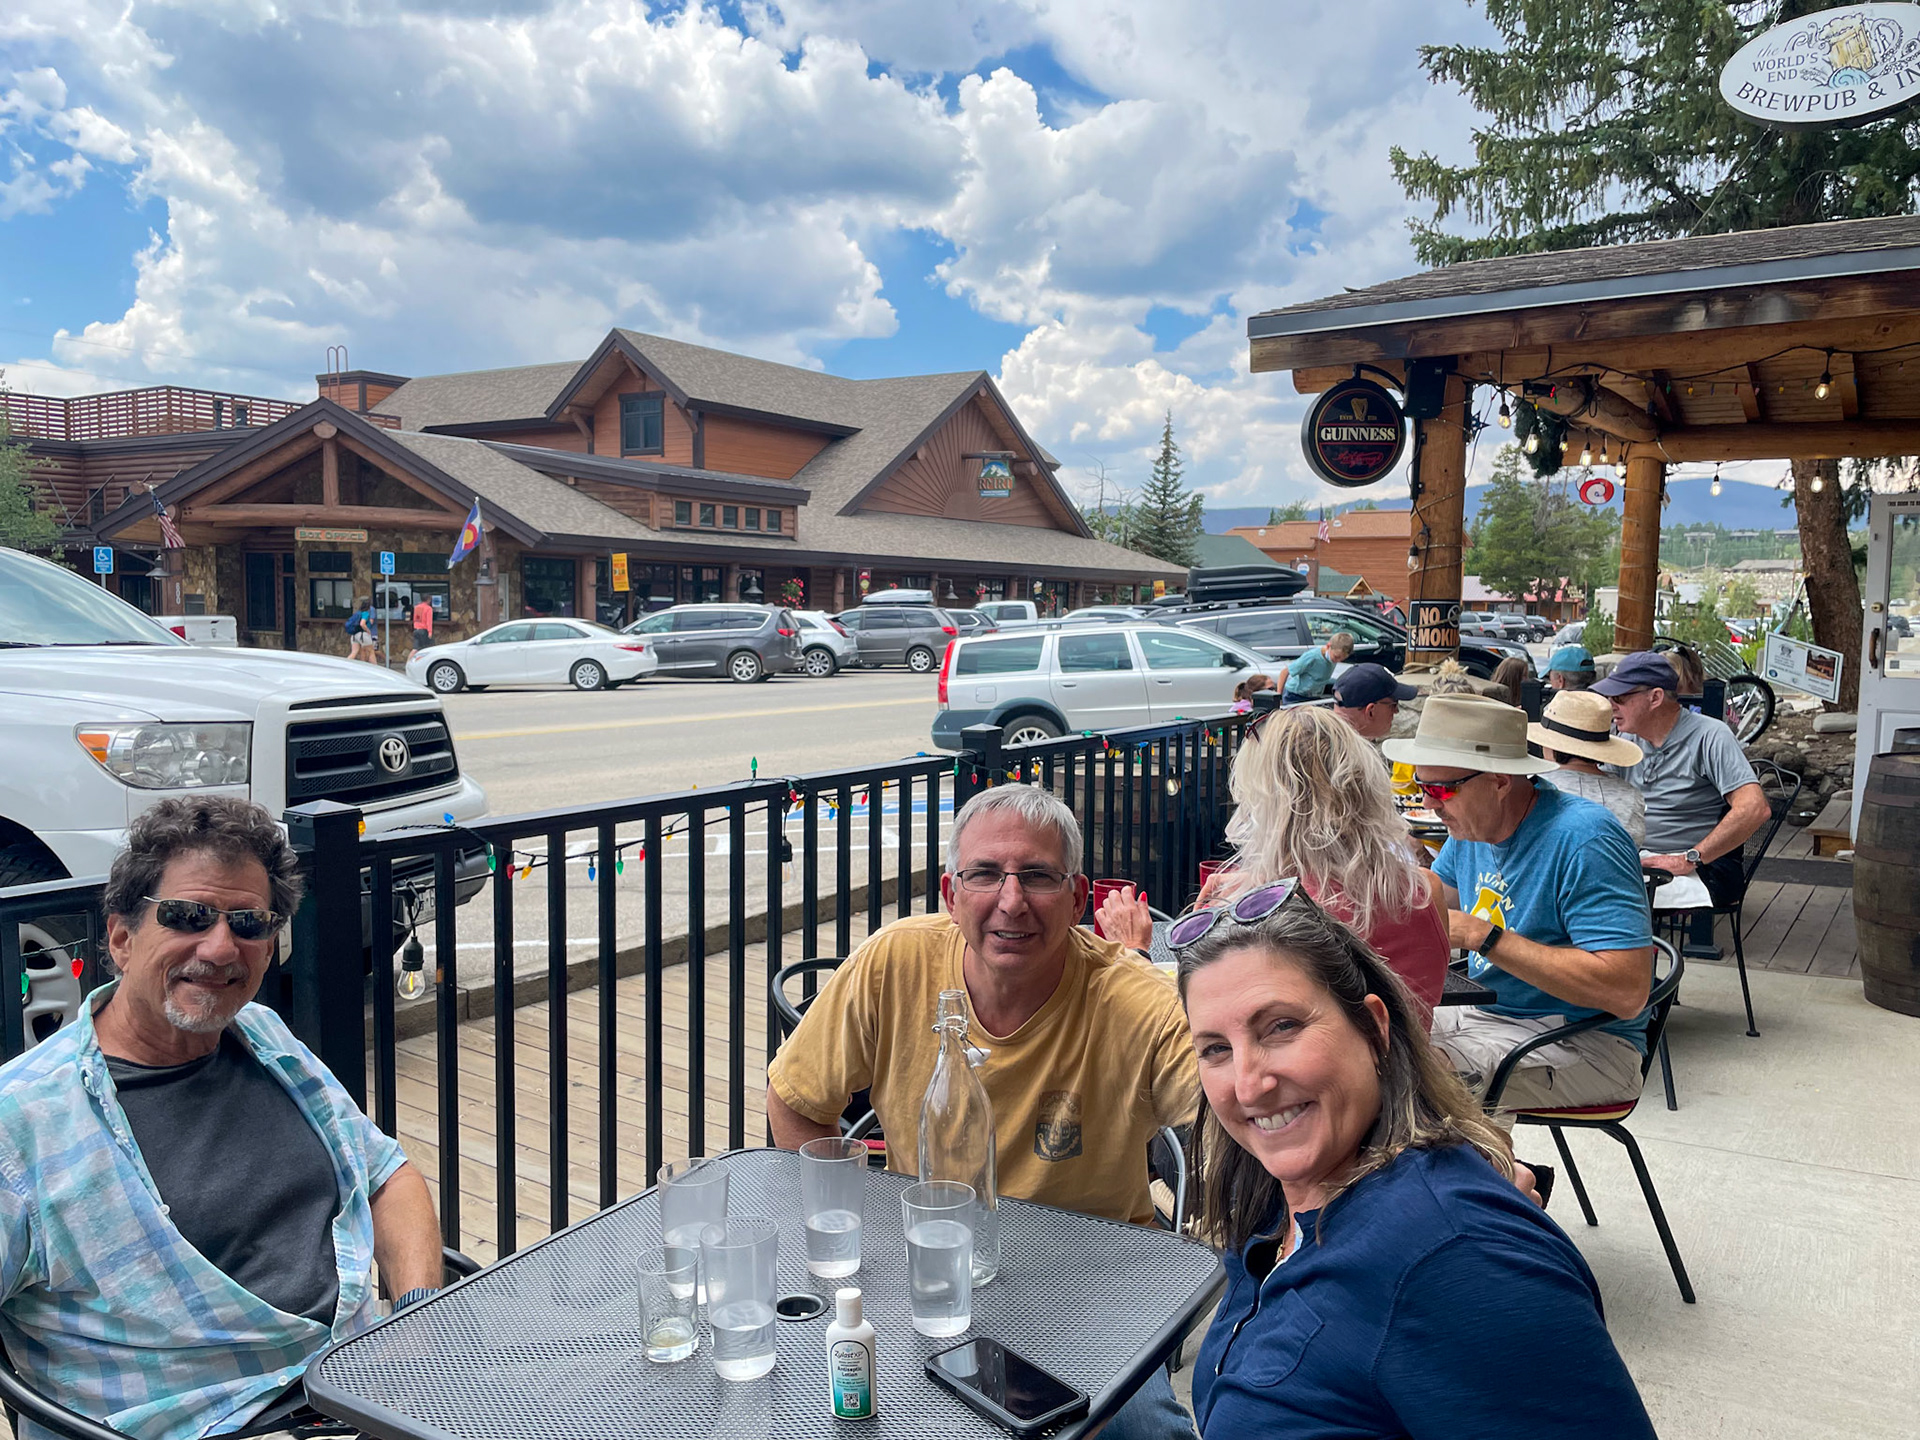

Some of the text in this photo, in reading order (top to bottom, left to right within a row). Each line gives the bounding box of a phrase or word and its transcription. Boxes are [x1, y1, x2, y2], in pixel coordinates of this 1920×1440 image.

[1757, 43, 1779, 58] the
[1752, 52, 1819, 73] WORLD'S
[1767, 69, 1798, 83] END
[1735, 81, 1857, 113] BREWPUB
[1868, 81, 1887, 100] &
[1320, 427, 1396, 441] GUINNESS
[325, 531, 364, 541] OFFICE
[1420, 607, 1440, 625] NO
